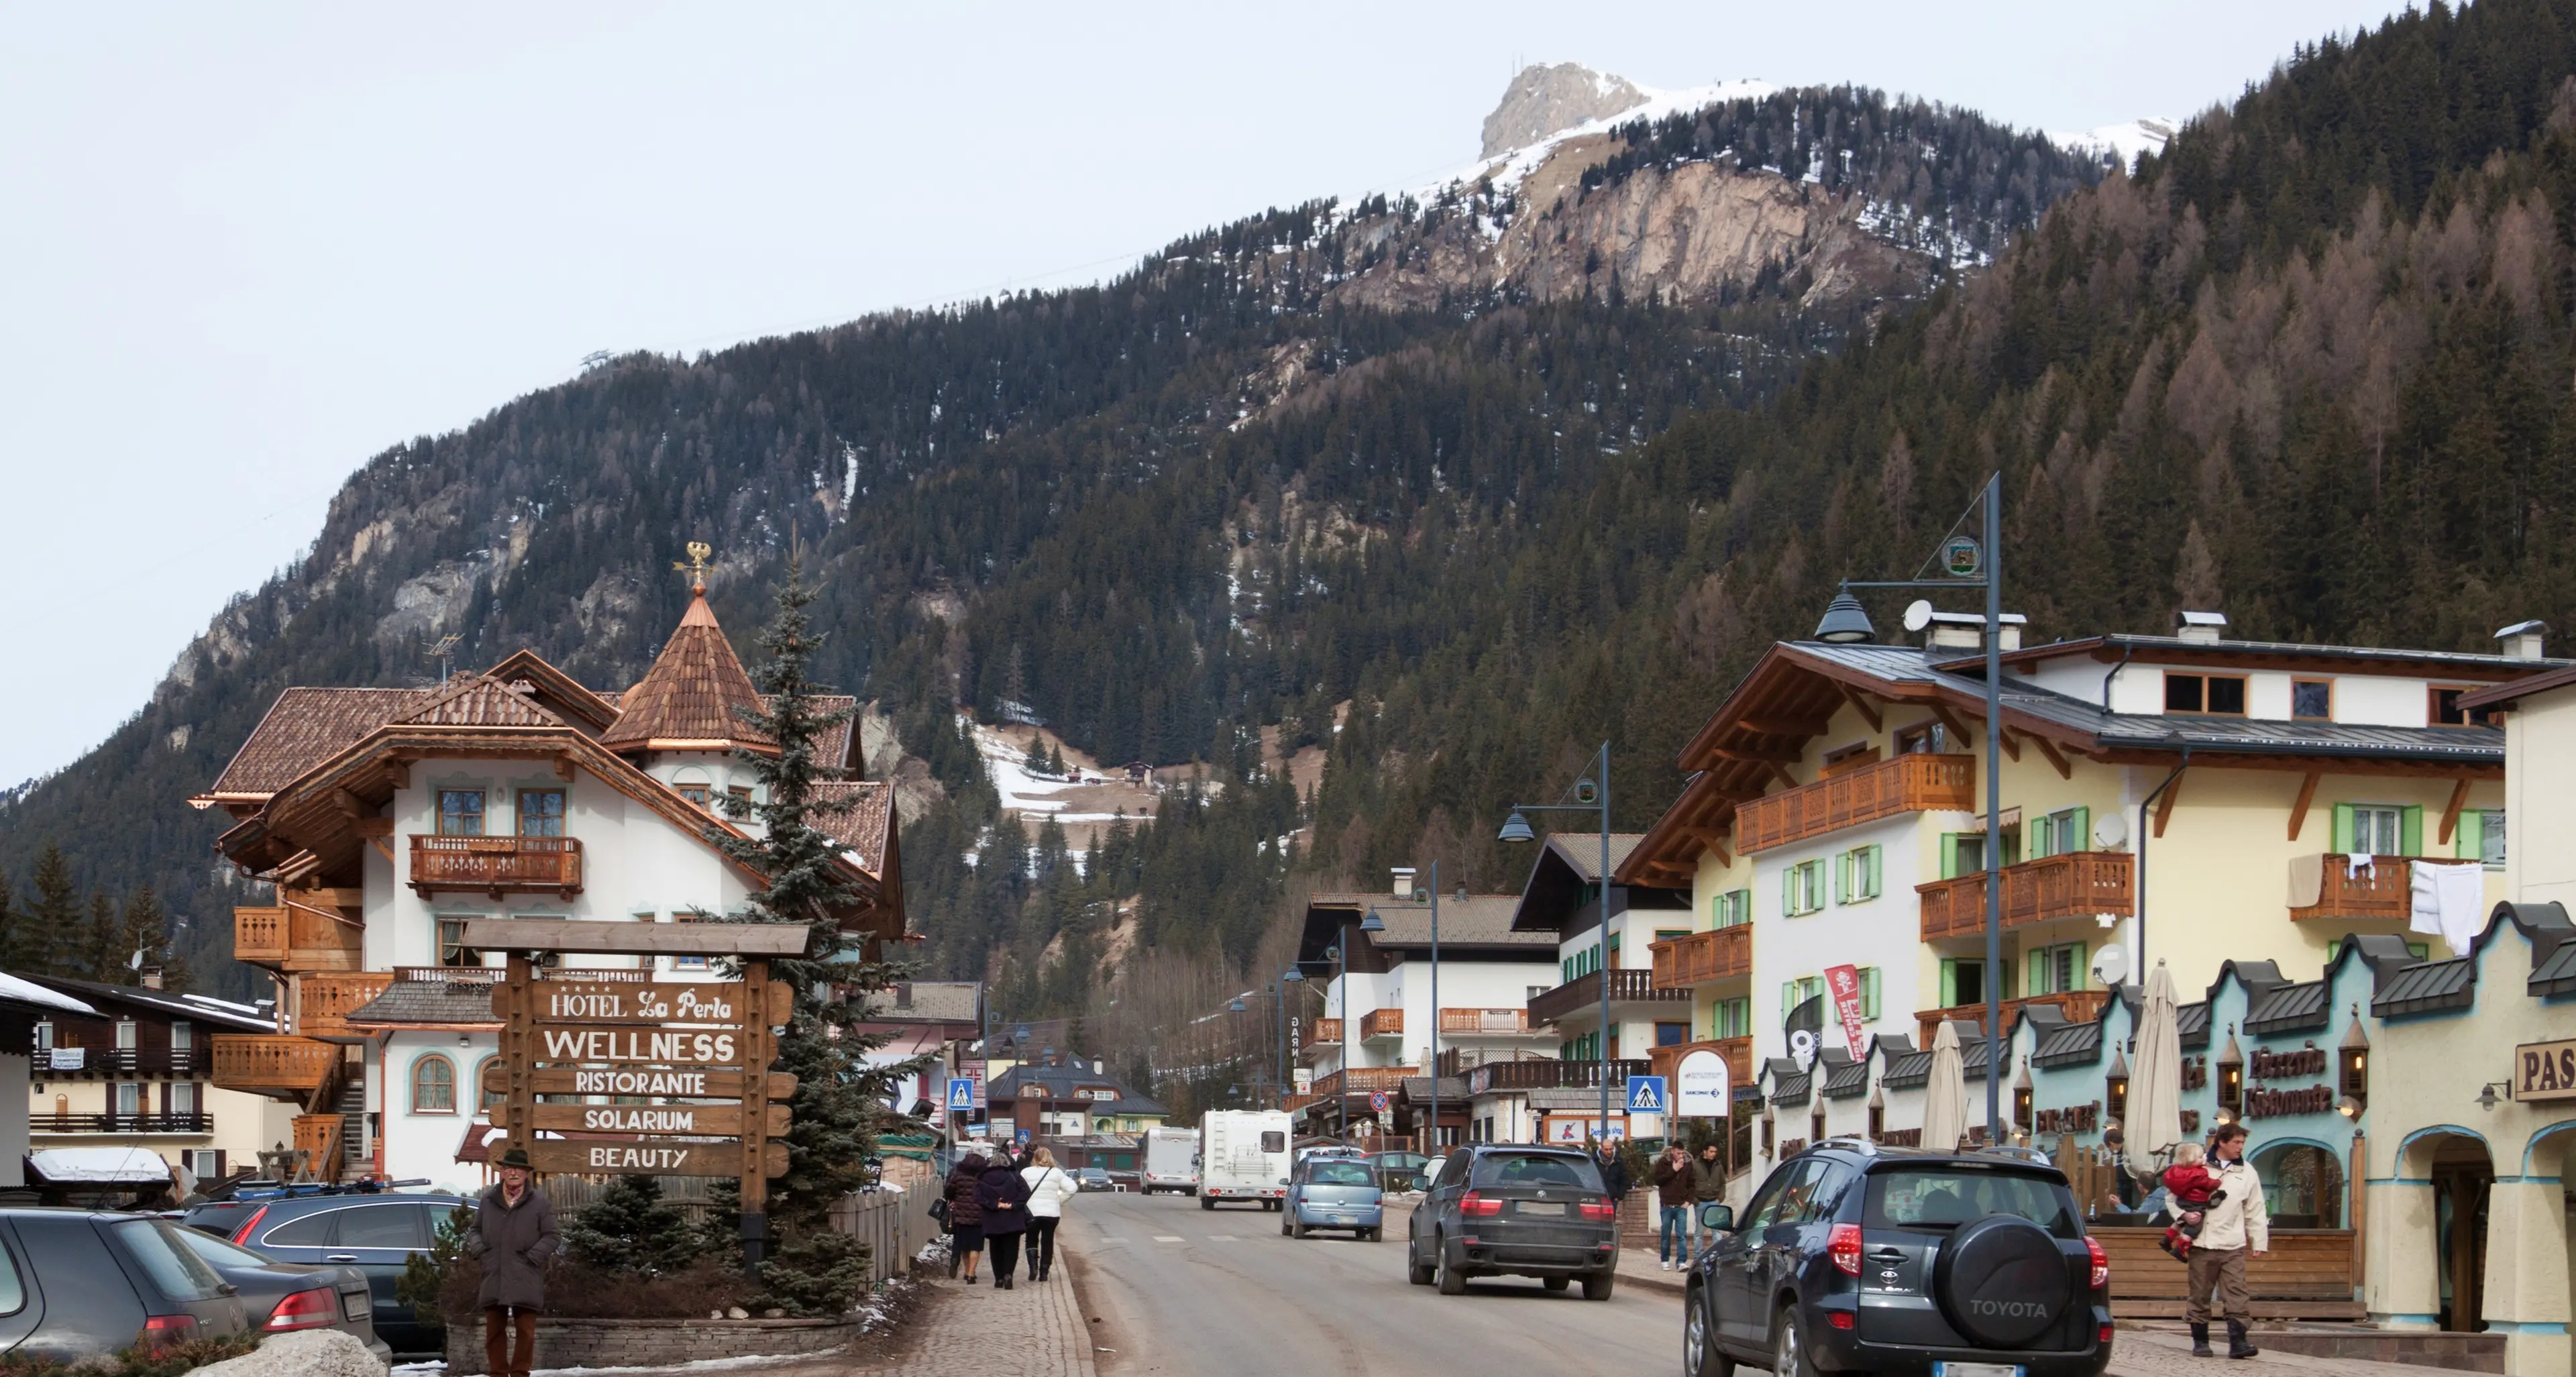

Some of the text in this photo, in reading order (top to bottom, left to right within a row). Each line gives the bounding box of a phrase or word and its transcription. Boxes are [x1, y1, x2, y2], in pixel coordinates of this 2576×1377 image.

[551, 987, 731, 1018] HOTEL La Perla
[544, 1030, 735, 1061] WELLNESS
[576, 1071, 705, 1094] RISTORANTE
[585, 1109, 693, 1130] SOLARIUM
[590, 1147, 688, 1168] BEAUTY
[1970, 1299, 2047, 1318] TOYOTA
